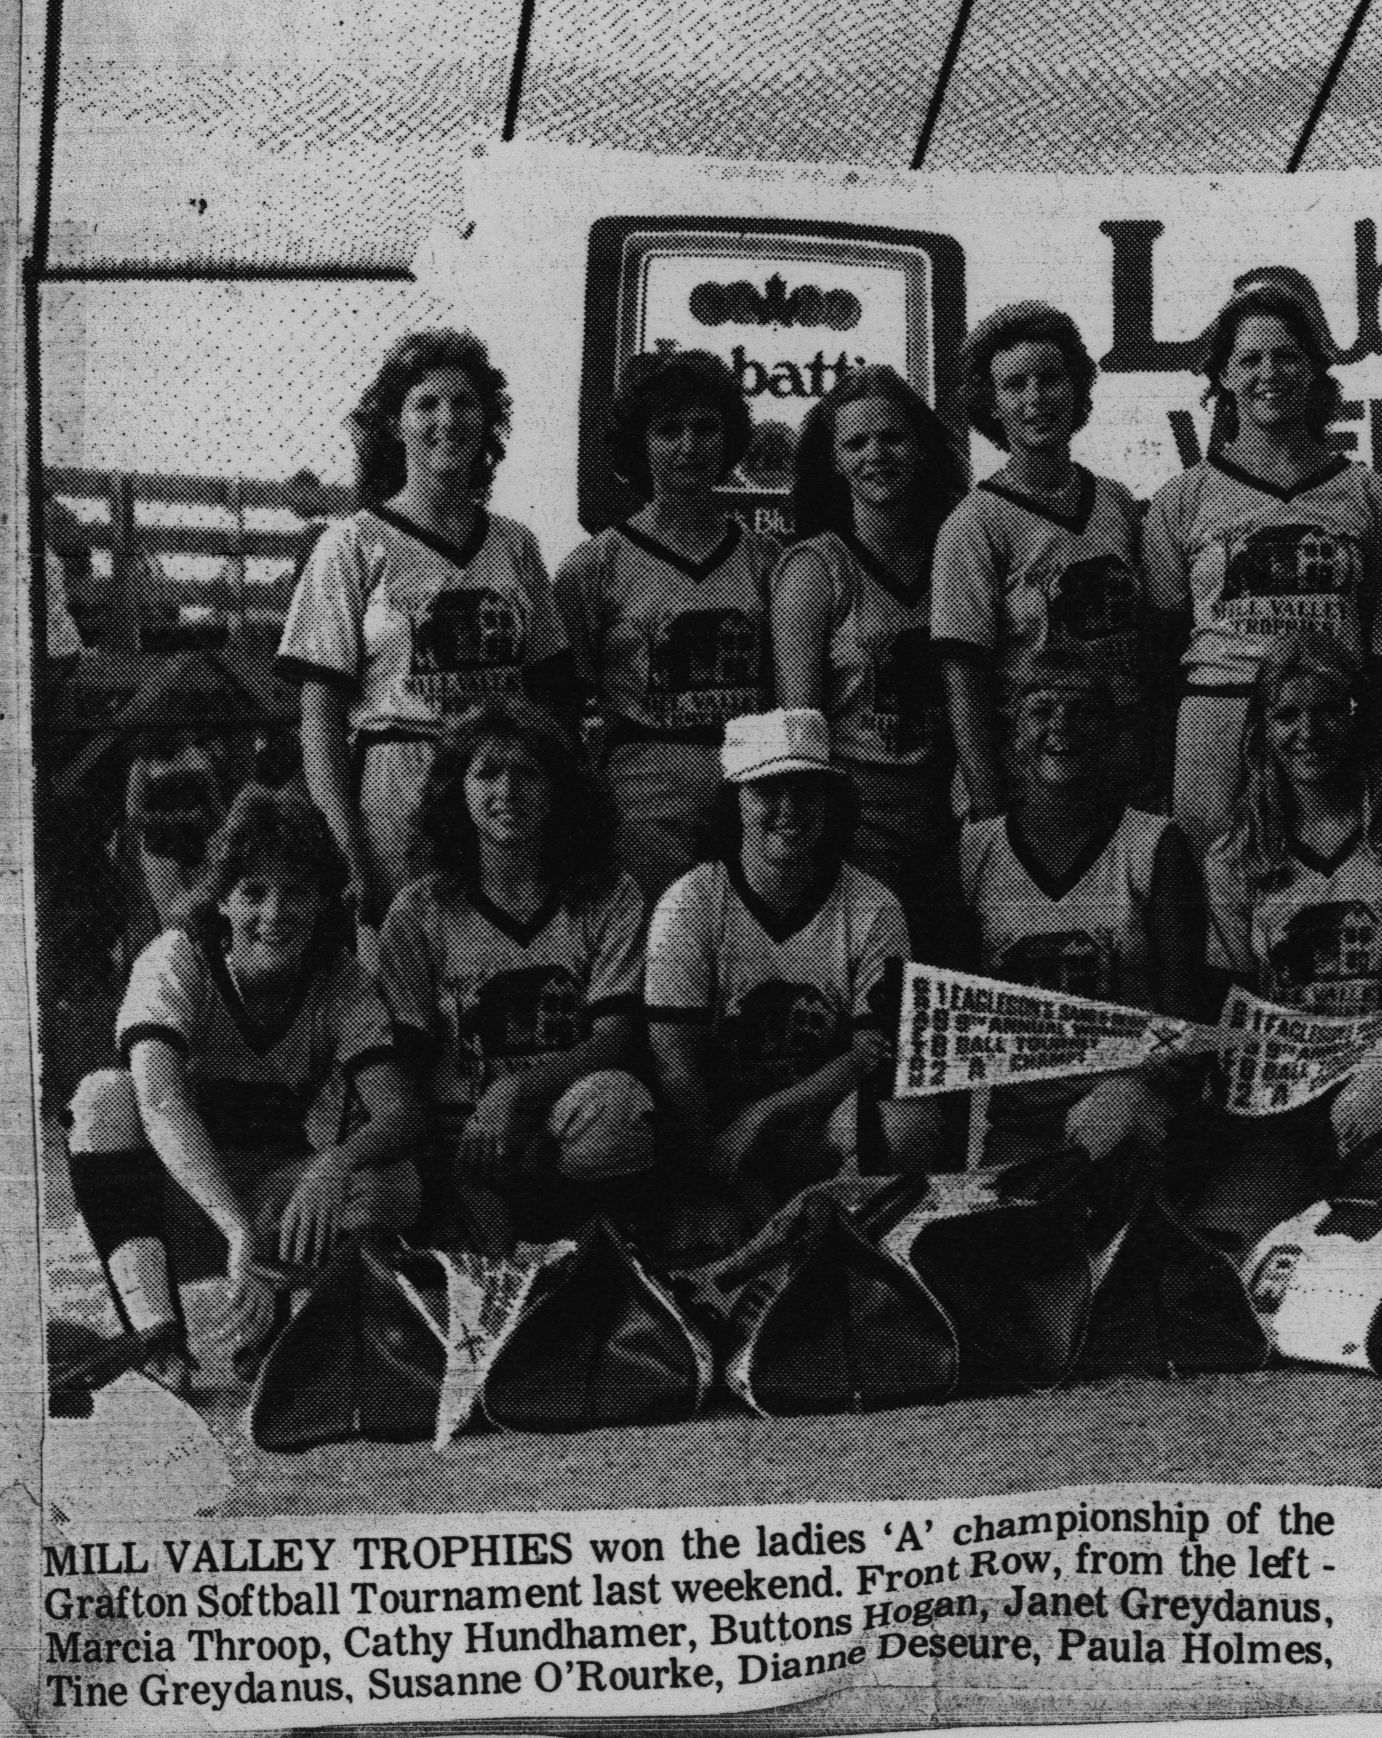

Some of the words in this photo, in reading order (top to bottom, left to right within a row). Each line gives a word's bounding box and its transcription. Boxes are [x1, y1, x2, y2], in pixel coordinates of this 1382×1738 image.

[955, 1035, 1006, 1055] BALL
[41, 1541, 149, 1577] MILL
[163, 1538, 336, 1574] VALLEY
[353, 1532, 573, 1570] TROPHIES
[589, 1538, 664, 1563] won
[681, 1527, 740, 1560] the
[756, 1522, 866, 1557] ladies
[953, 1500, 1209, 1546] championship
[1226, 1501, 1262, 1535] of
[1279, 1502, 1335, 1536] the
[44, 1584, 187, 1622] Grafton
[197, 1581, 340, 1618] Softball
[350, 1576, 582, 1614] Tournament
[593, 1573, 661, 1606] last
[671, 1565, 842, 1603] weekend.
[857, 1556, 960, 1596] Front
[969, 1550, 1062, 1581] Row,
[1075, 1541, 1163, 1575] from
[1179, 1544, 1236, 1578] the
[1248, 1545, 1310, 1579] left
[45, 1629, 176, 1665] Marcia
[187, 1628, 331, 1668] Throop,
[344, 1624, 453, 1664] Cathy
[464, 1617, 697, 1654] Hundhamer,
[710, 1612, 852, 1646] Buttons
[863, 1594, 989, 1631] Hogan,
[1003, 1584, 1109, 1619] Janet
[1119, 1586, 1333, 1630] Greydanus,
[46, 1674, 128, 1708] Tine
[139, 1671, 353, 1711] Greydanus,
[369, 1668, 521, 1700] Susanne
[534, 1656, 723, 1693] O'Rourke,
[738, 1645, 866, 1685] Dianne
[876, 1632, 1041, 1667] Deseure,
[1057, 1628, 1166, 1664] Paula
[1181, 1631, 1332, 1669] Holmes,
